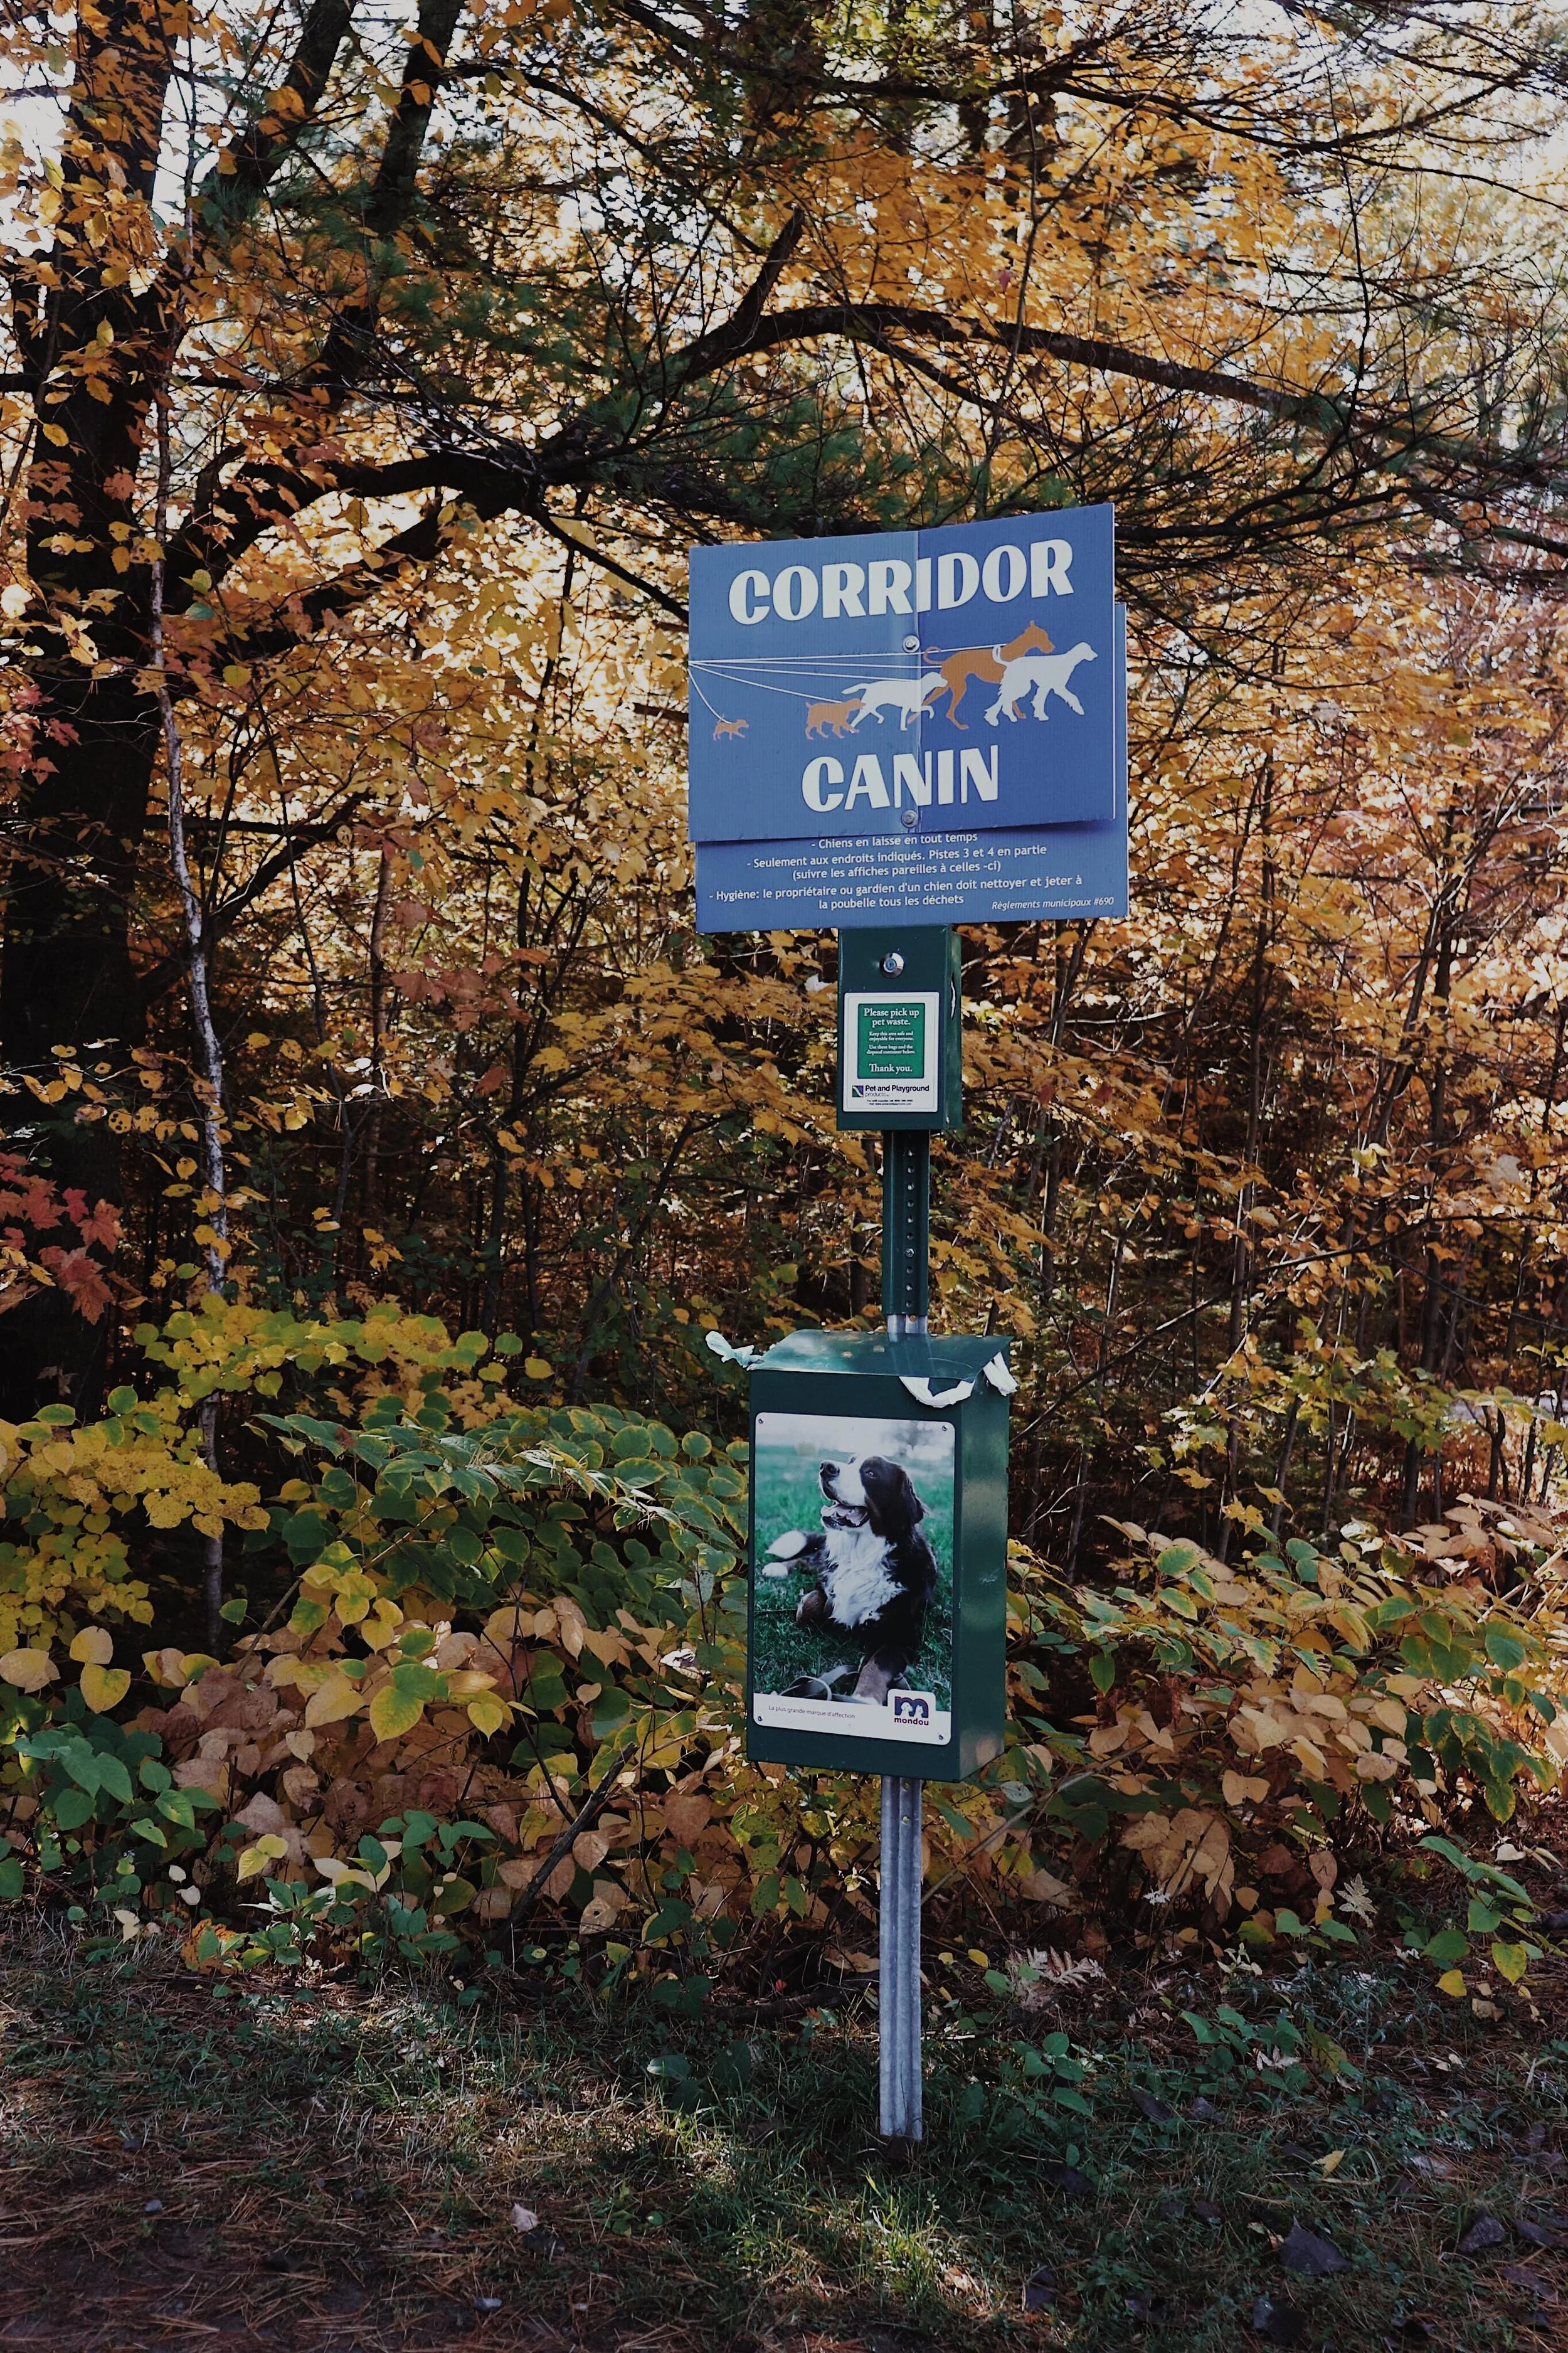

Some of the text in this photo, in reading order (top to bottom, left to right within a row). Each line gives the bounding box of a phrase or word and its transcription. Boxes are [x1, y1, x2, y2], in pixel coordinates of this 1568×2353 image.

[728, 538, 1074, 625] CORRIDOR
[801, 745, 999, 812] CANIN
[818, 839, 852, 849] Chiens
[872, 837, 901, 846] laisse
[904, 836, 917, 844] en
[921, 834, 942, 844] tout
[946, 833, 978, 844] temps
[754, 857, 807, 868] Seulement
[810, 856, 828, 865] aux
[832, 853, 874, 863] endroits
[877, 851, 925, 864] indiqués.
[929, 849, 960, 859] Pistes
[963, 849, 969, 858] 3
[973, 848, 984, 857] et
[988, 848, 994, 857] 4
[998, 848, 1011, 856] en
[1014, 845, 1046, 858] partie
[793, 860, 1001, 881] (suivre les affiches pareilles à celles -ci)
[716, 890, 760, 902] Hygiène:
[763, 889, 772, 898] le
[775, 884, 837, 898] propriétaire
[840, 886, 853, 895] ou
[856, 883, 894, 895] gardien
[898, 882, 921, 892] d'un
[924, 880, 952, 891] chien
[956, 878, 977, 890] doit
[980, 876, 1027, 890] nettoyer
[1030, 876, 1041, 886] et
[1044, 875, 1071, 888] jeter
[1075, 875, 1082, 884] à
[818, 893, 963, 910] la poubelle tous les déchets
[1042, 898, 1091, 908] municipaux
[1093, 896, 1114, 906] #690
[864, 1008, 919, 1017] Please pick up
[872, 1019, 884, 1028] pet
[869, 1063, 912, 1075] Thank you.
[894, 1717, 929, 1726] mondou
